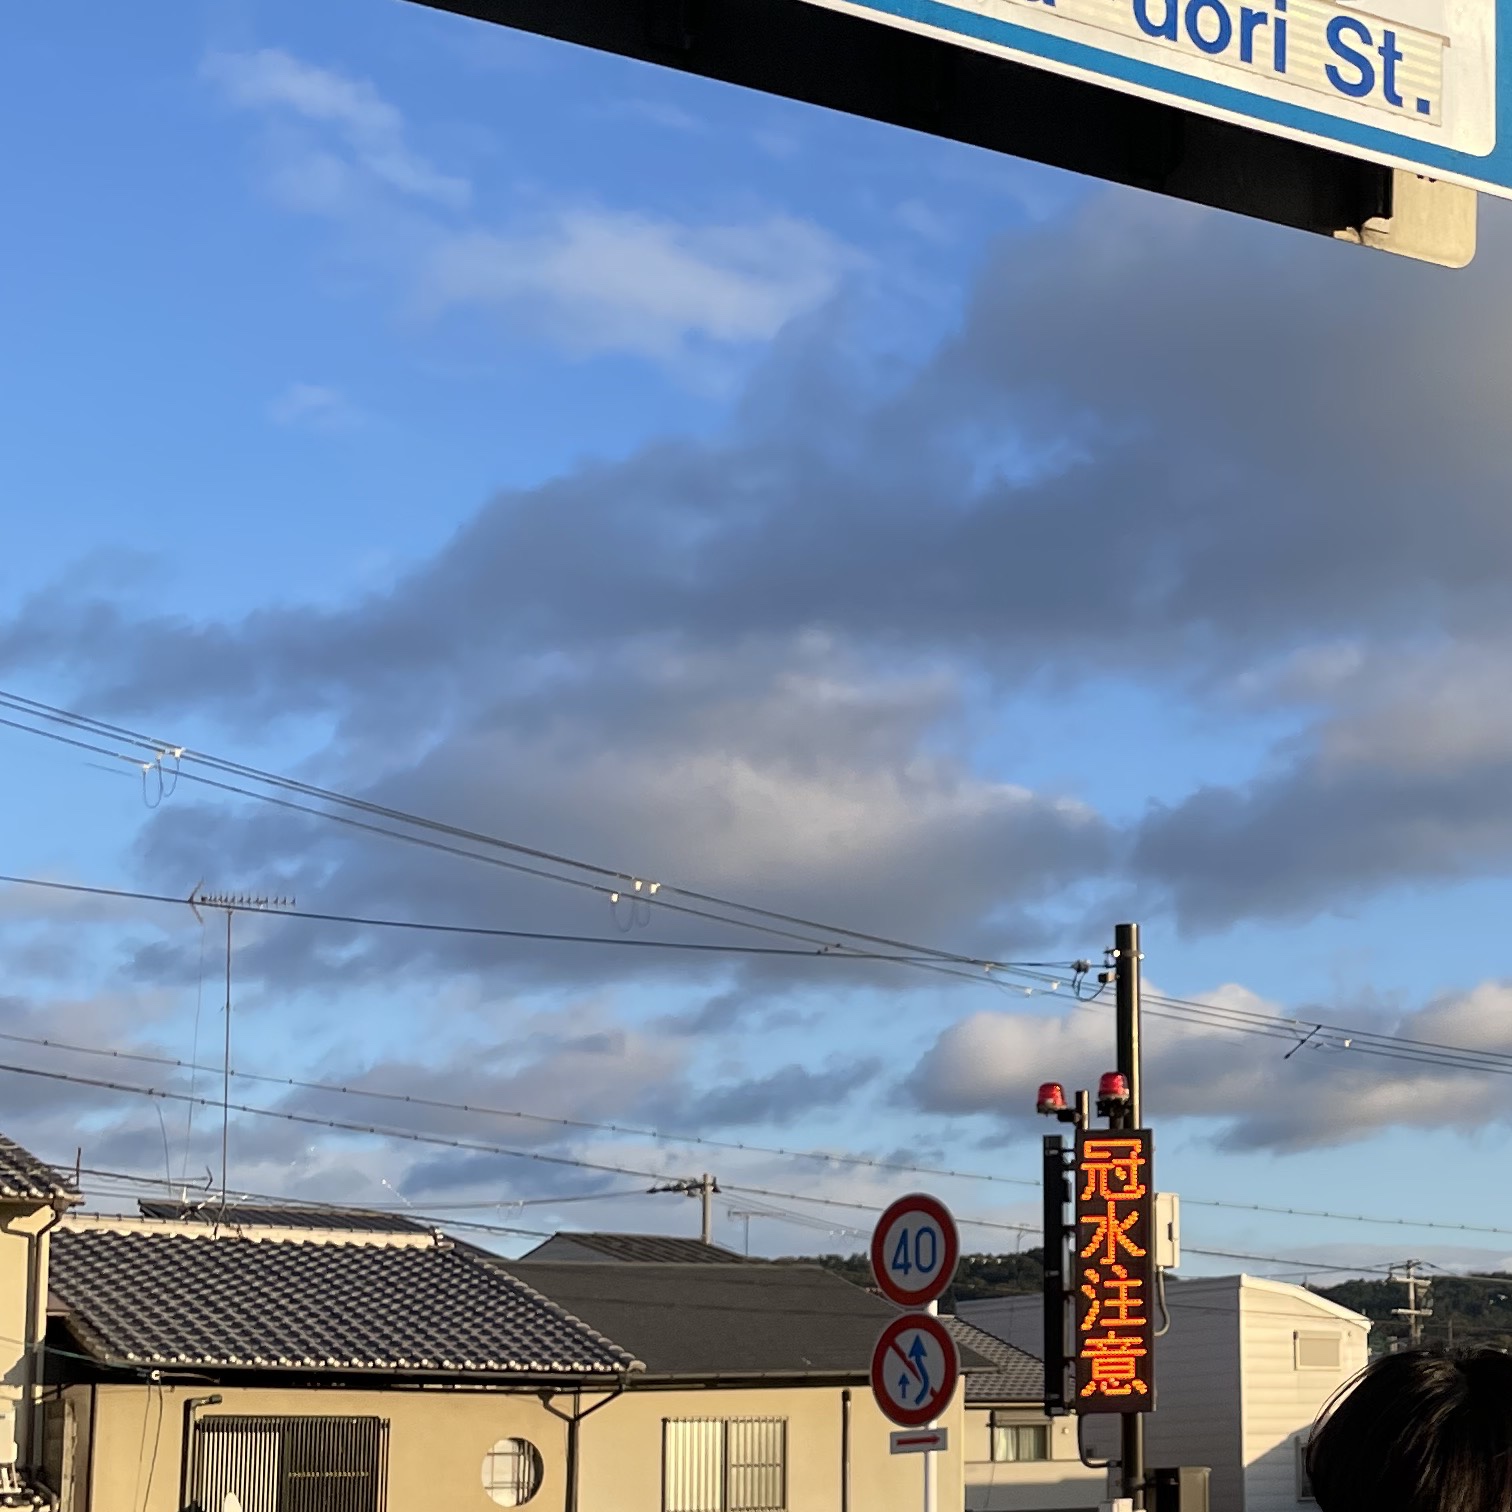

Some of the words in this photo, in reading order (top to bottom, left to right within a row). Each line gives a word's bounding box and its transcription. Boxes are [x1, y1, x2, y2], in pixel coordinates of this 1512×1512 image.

[1324, 15, 1430, 116] St.
[891, 1226, 937, 1275] 40
[1080, 1139, 1147, 1397] 冠水注意
